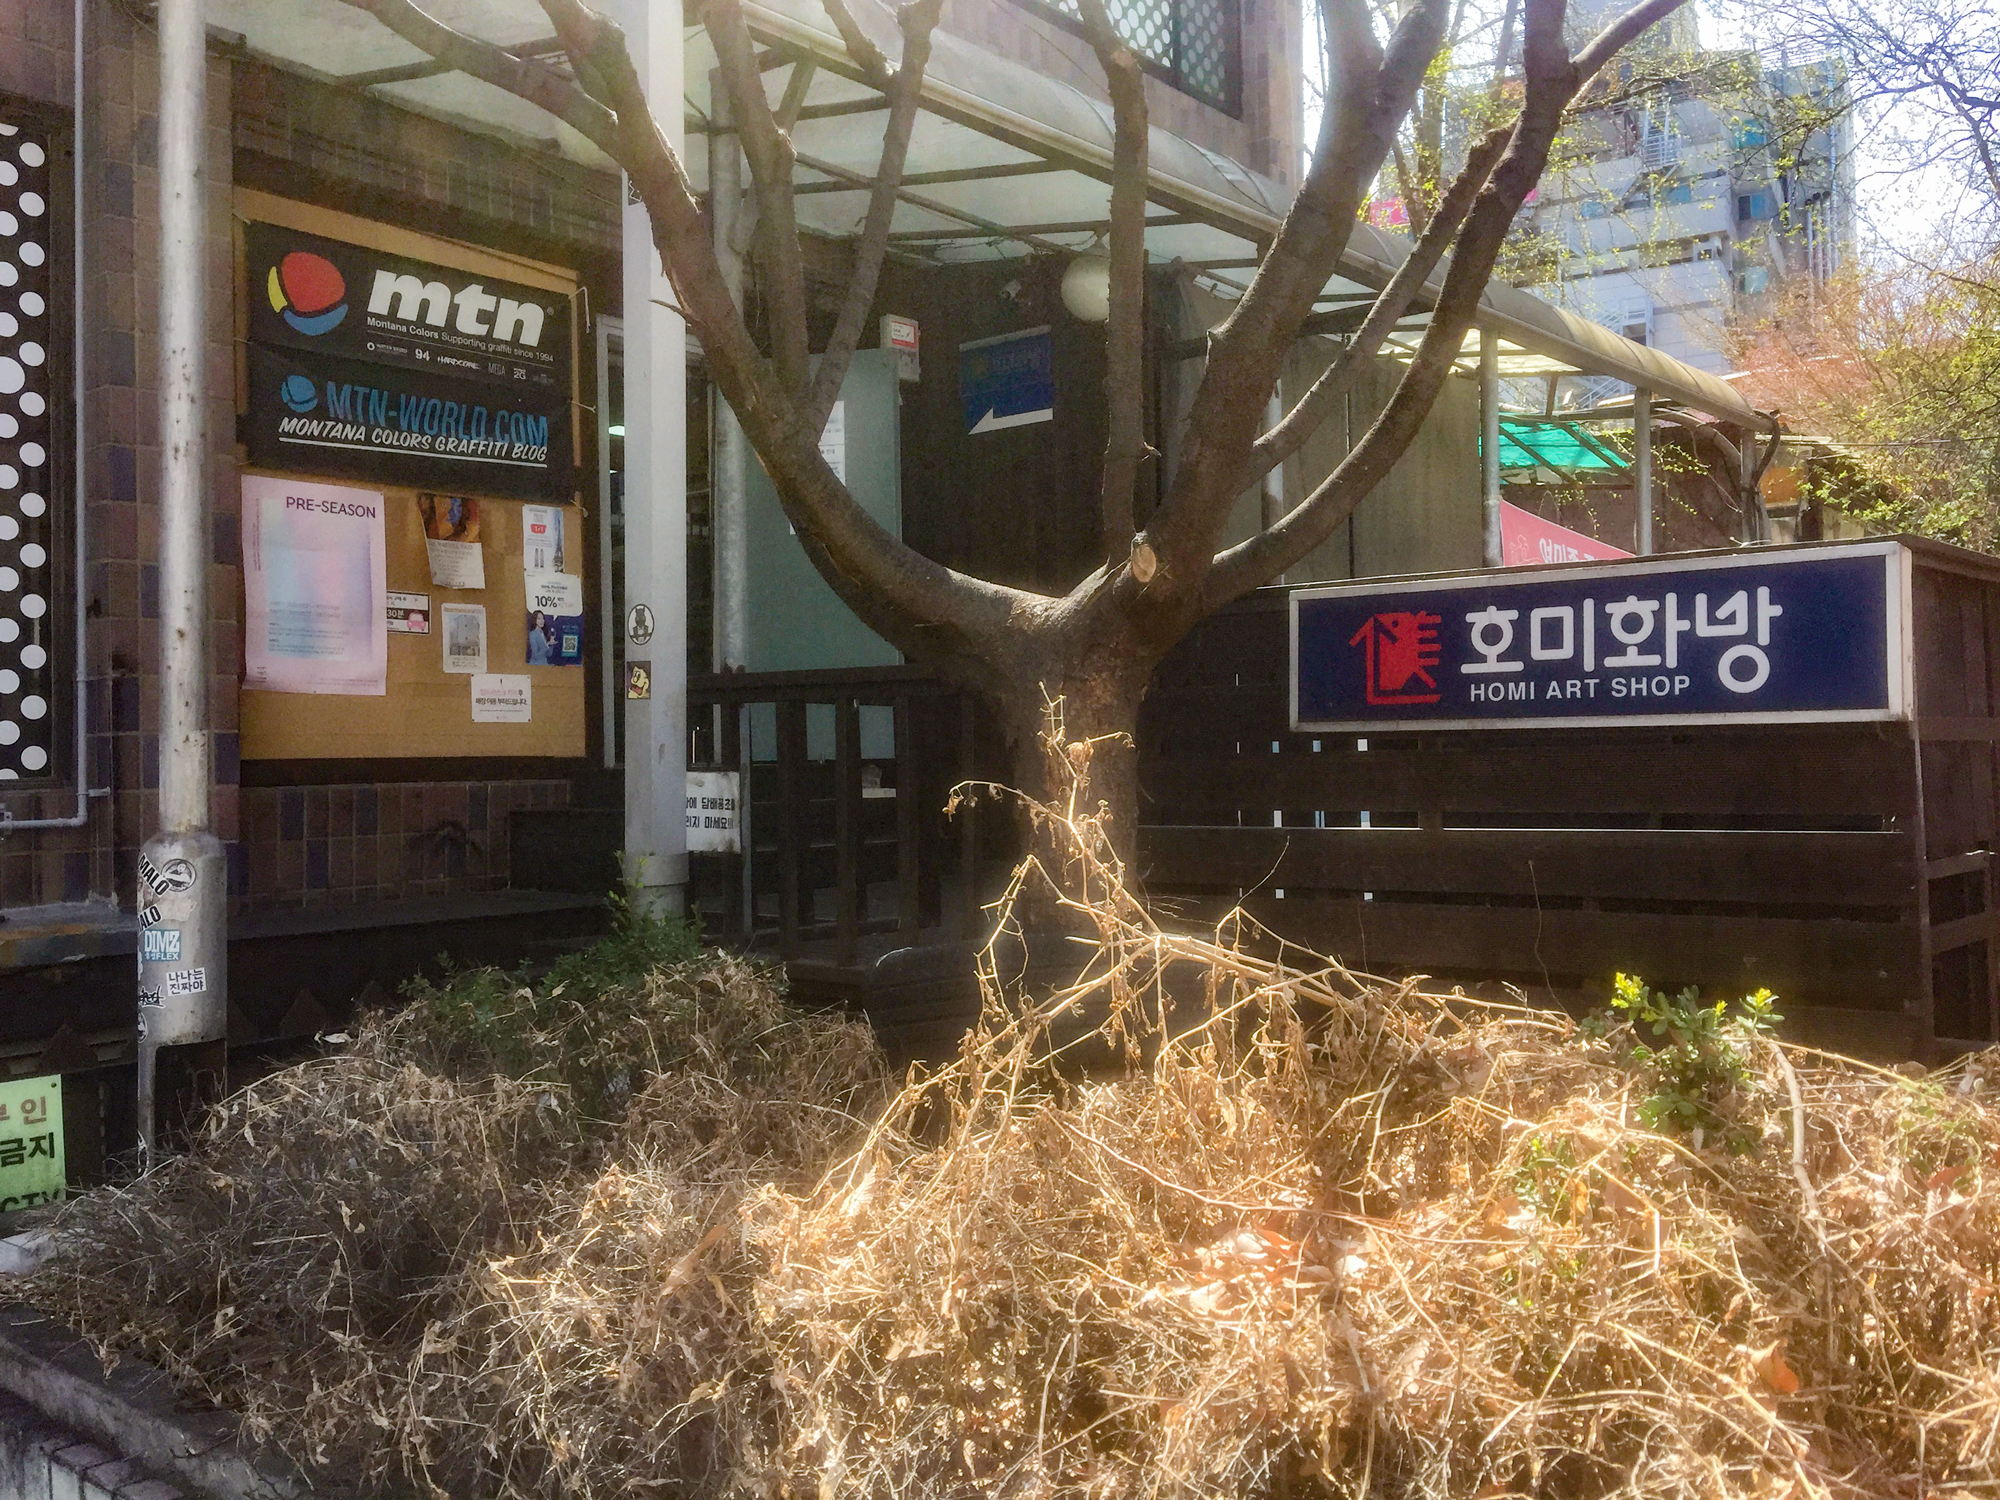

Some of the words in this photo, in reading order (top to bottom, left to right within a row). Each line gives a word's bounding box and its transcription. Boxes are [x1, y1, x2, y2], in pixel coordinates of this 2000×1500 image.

[367, 269, 545, 347] mtn
[366, 316, 407, 333] Montana
[409, 324, 439, 339] Colors
[441, 331, 486, 350] Supporting
[487, 341, 512, 354] graffiti
[513, 347, 534, 359] since
[536, 351, 554, 363] 1994
[415, 348, 431, 362] 94
[326, 380, 549, 448] MTN-WORLD.COM
[278, 416, 366, 442] MONTANA
[371, 427, 432, 451] COLORS
[435, 437, 509, 455] GRAFFITI
[511, 444, 548, 462] BLOG
[286, 496, 376, 519] PRE-SEASON
[534, 595, 558, 608] 10%
[1460, 585, 1784, 694] 호미화방
[1469, 682, 1535, 702] HOMI
[1545, 679, 1600, 699] ART
[1611, 675, 1692, 697] SHOP
[138, 854, 171, 896] MALO
[138, 905, 162, 933] ALO
[144, 930, 180, 954] DIMZ
[168, 968, 204, 982] 나나는
[169, 981, 204, 995] 진짜야
